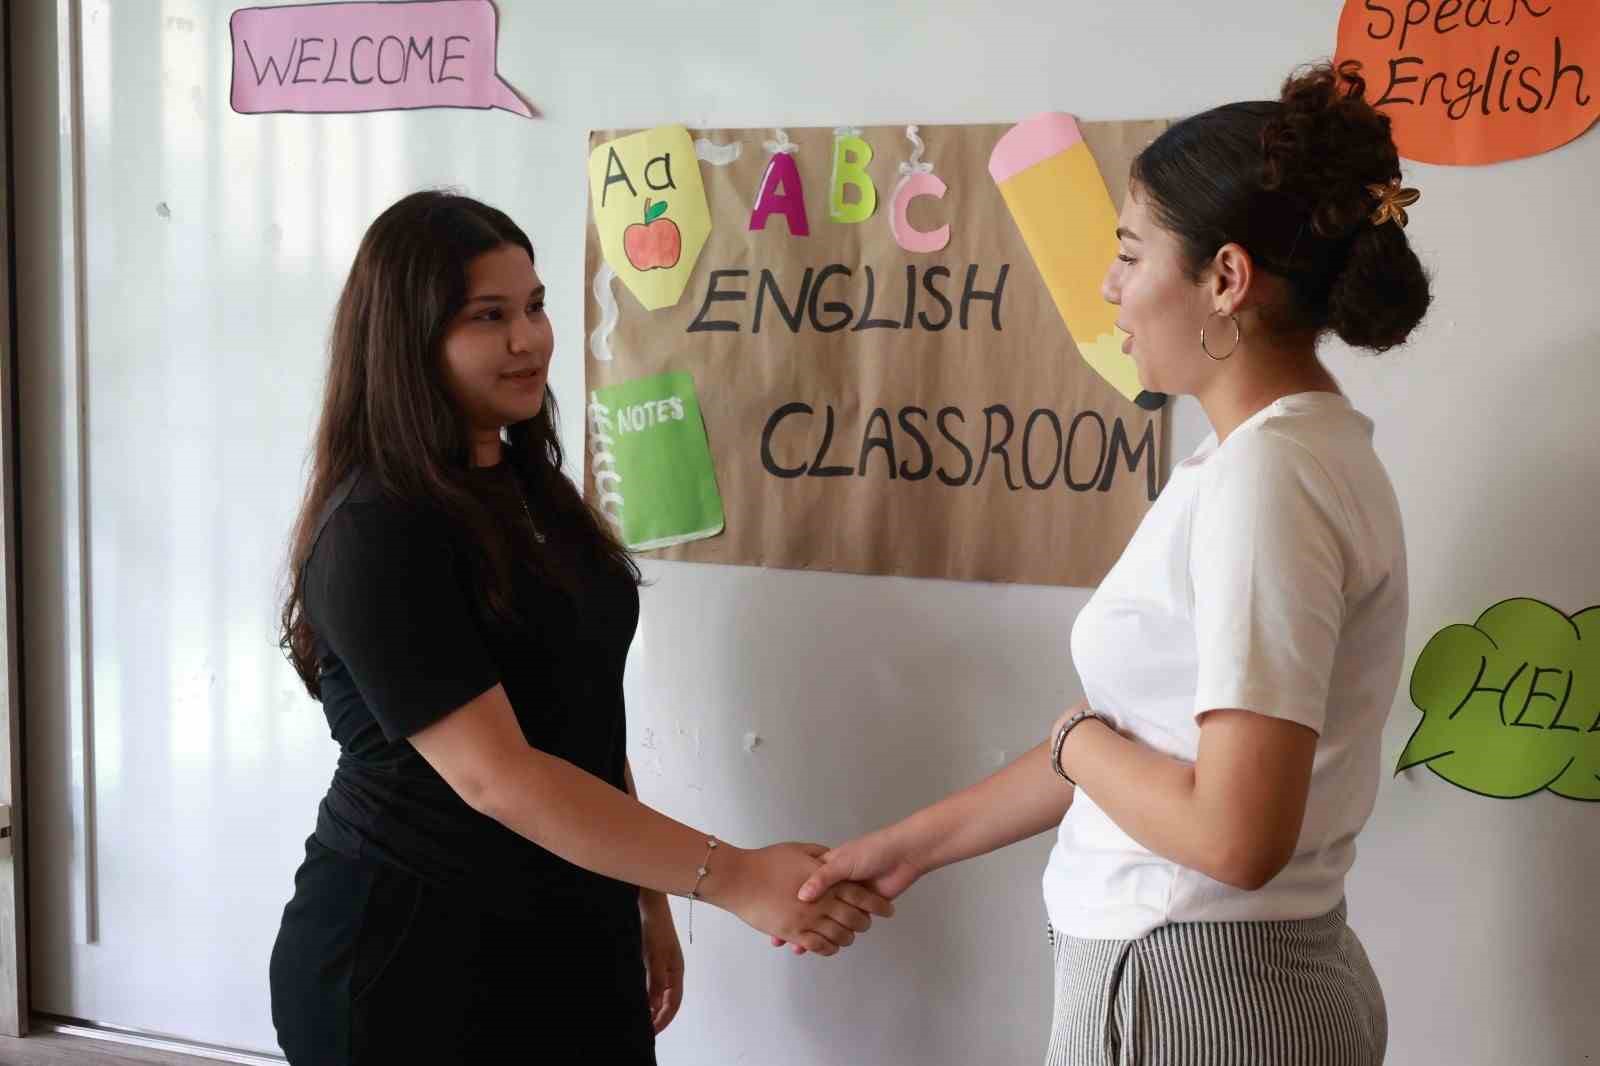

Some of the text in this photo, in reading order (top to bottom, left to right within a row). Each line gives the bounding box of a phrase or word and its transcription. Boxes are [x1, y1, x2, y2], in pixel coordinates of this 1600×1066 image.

[243, 36, 470, 85] WELCOME
[1373, 37, 1590, 121] English
[601, 146, 677, 207] Aa
[686, 263, 1010, 334] ENGLISH
[617, 396, 685, 435] NOTES
[760, 402, 1164, 502] CLASSROOM
[1448, 655, 1600, 733] HEL
